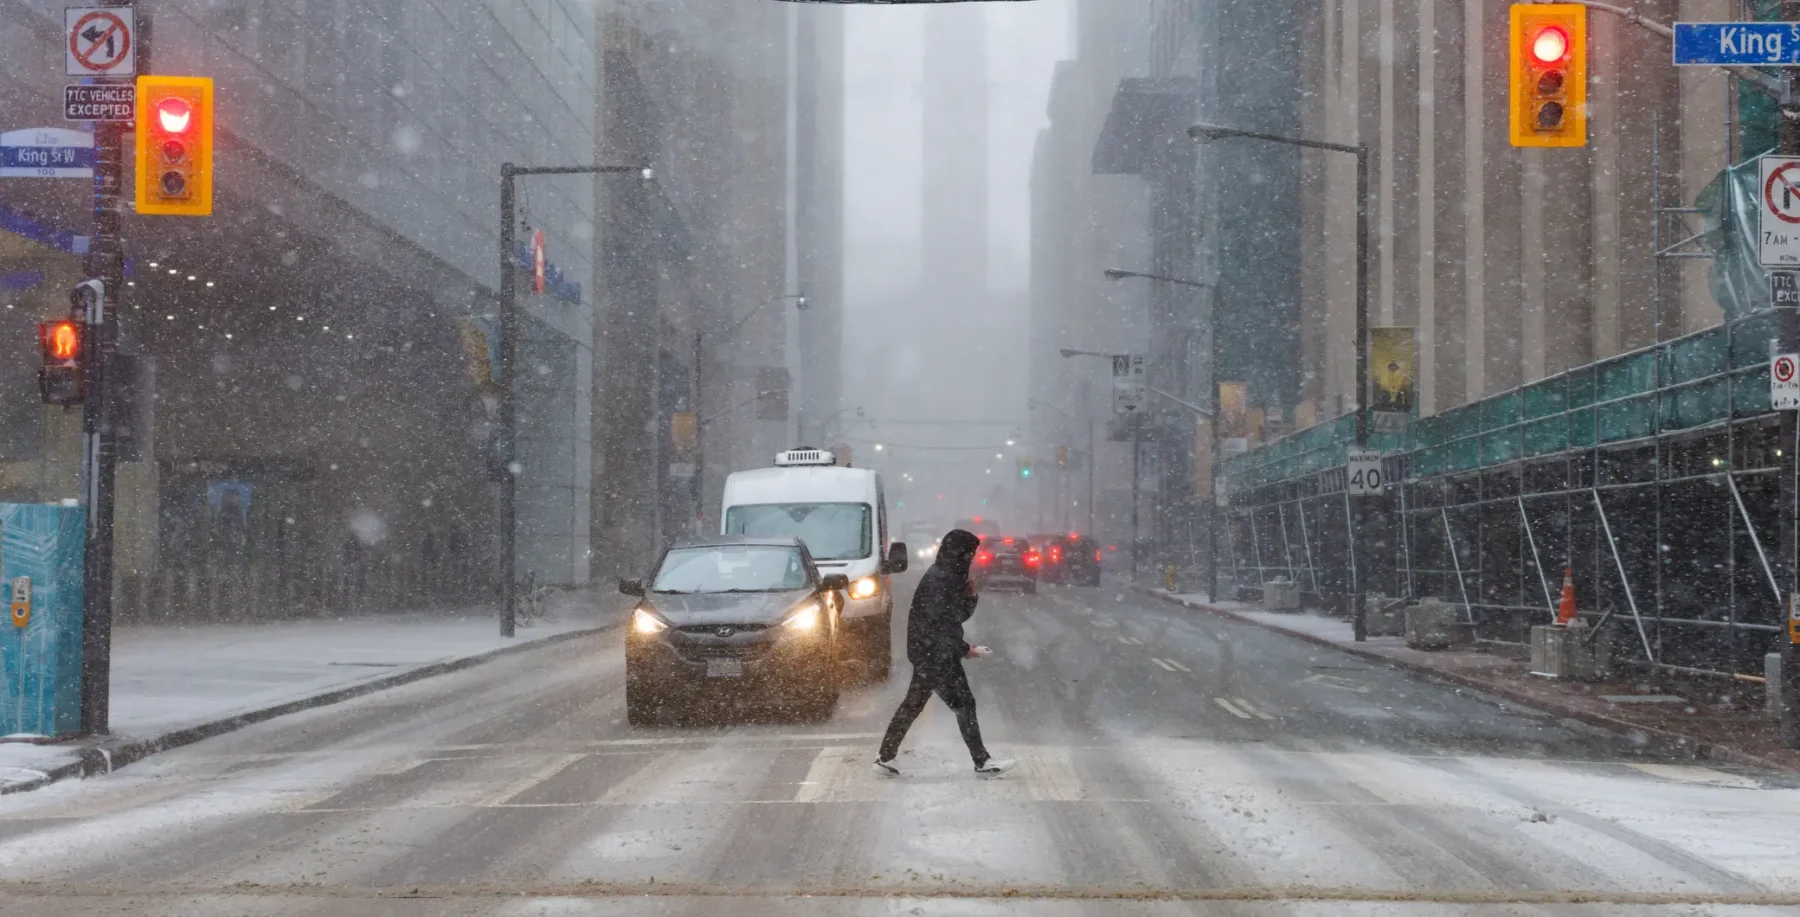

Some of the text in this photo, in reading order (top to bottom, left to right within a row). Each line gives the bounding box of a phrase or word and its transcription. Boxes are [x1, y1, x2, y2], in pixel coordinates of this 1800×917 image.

[1720, 26, 1800, 62] King S
[67, 90, 133, 101] TTC VEHICLES
[69, 104, 130, 115] EXCEPTED
[18, 148, 75, 165] King St W
[37, 168, 56, 176] 100
[1773, 276, 1791, 287] TTC
[1777, 291, 1800, 302] EXC
[1350, 468, 1381, 490] 40
